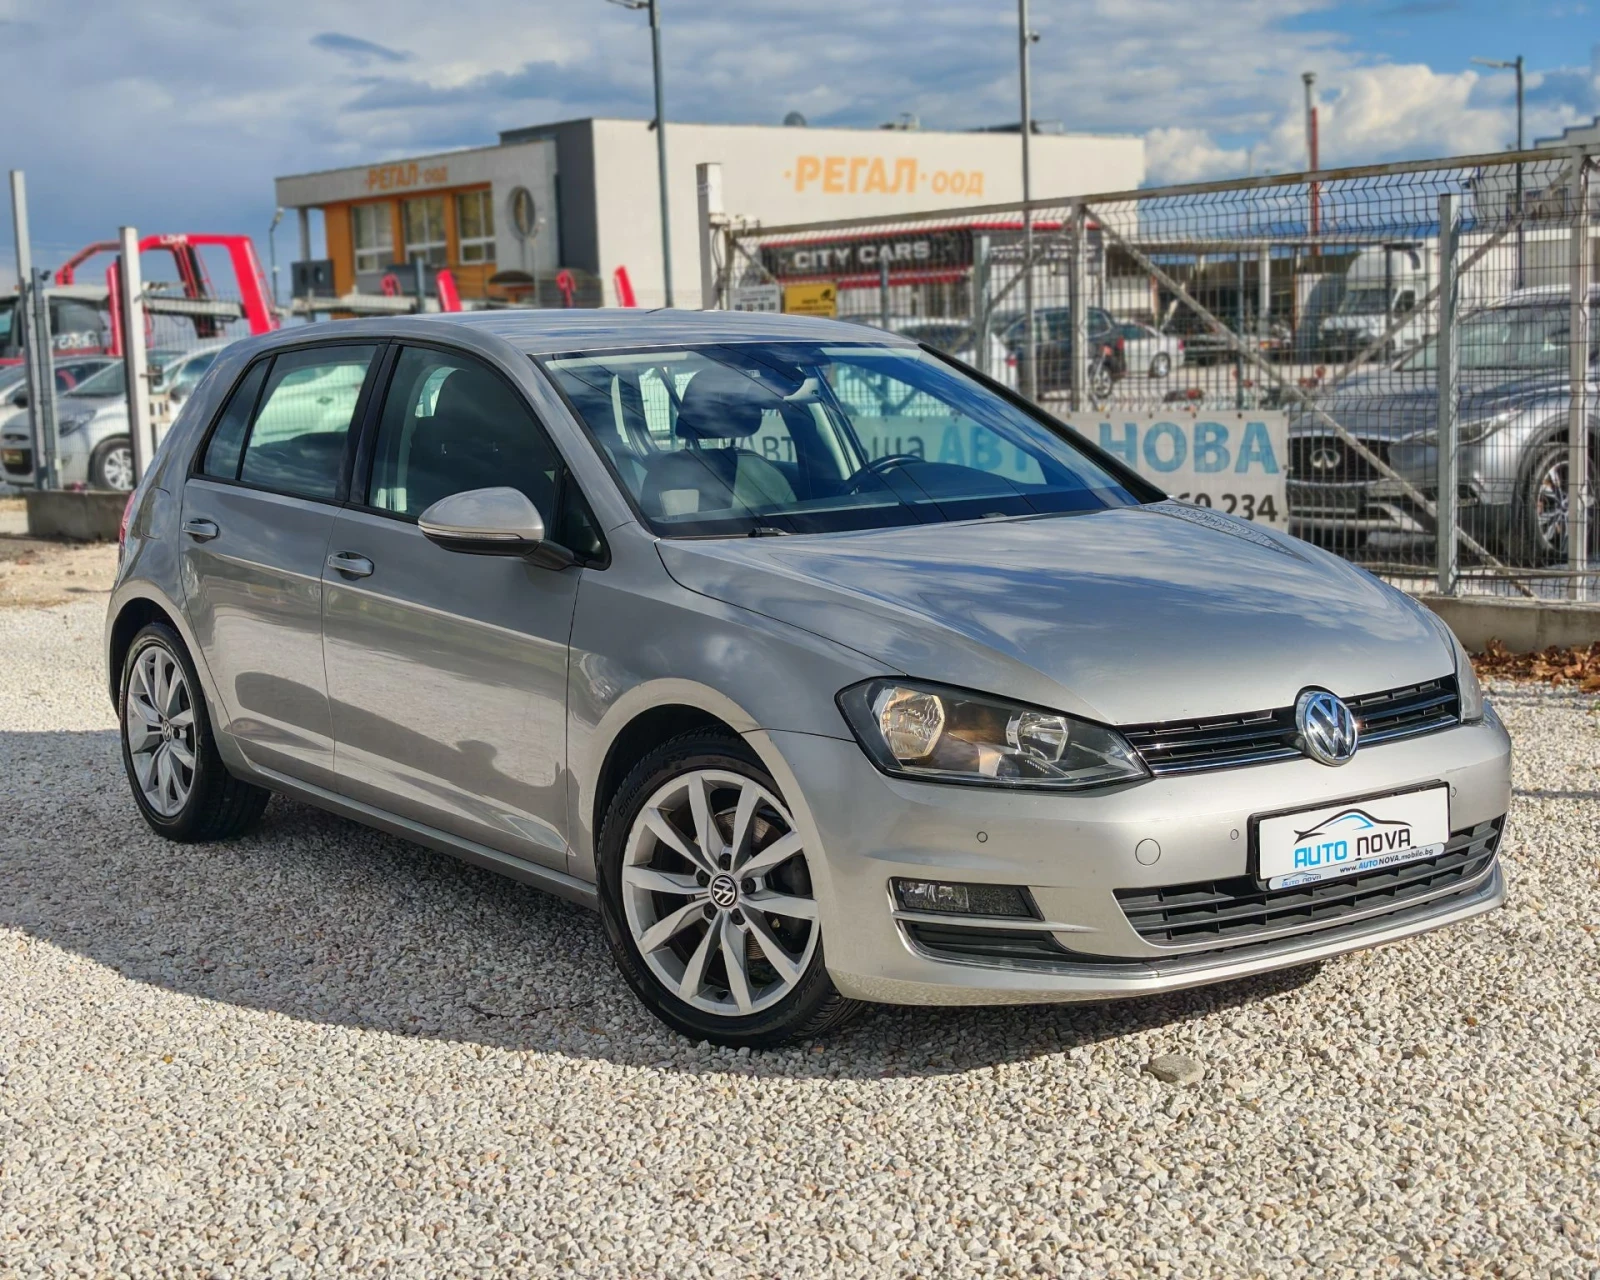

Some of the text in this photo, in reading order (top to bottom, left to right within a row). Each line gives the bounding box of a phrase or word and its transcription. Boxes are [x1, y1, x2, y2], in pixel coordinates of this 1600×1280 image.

[795, 155, 918, 195] РЕГАЛ
[794, 241, 931, 268] CITY CARS
[1098, 421, 1280, 474] НОВА
[1221, 493, 1278, 522] 234
[1294, 828, 1417, 869] AUTO NOVA
